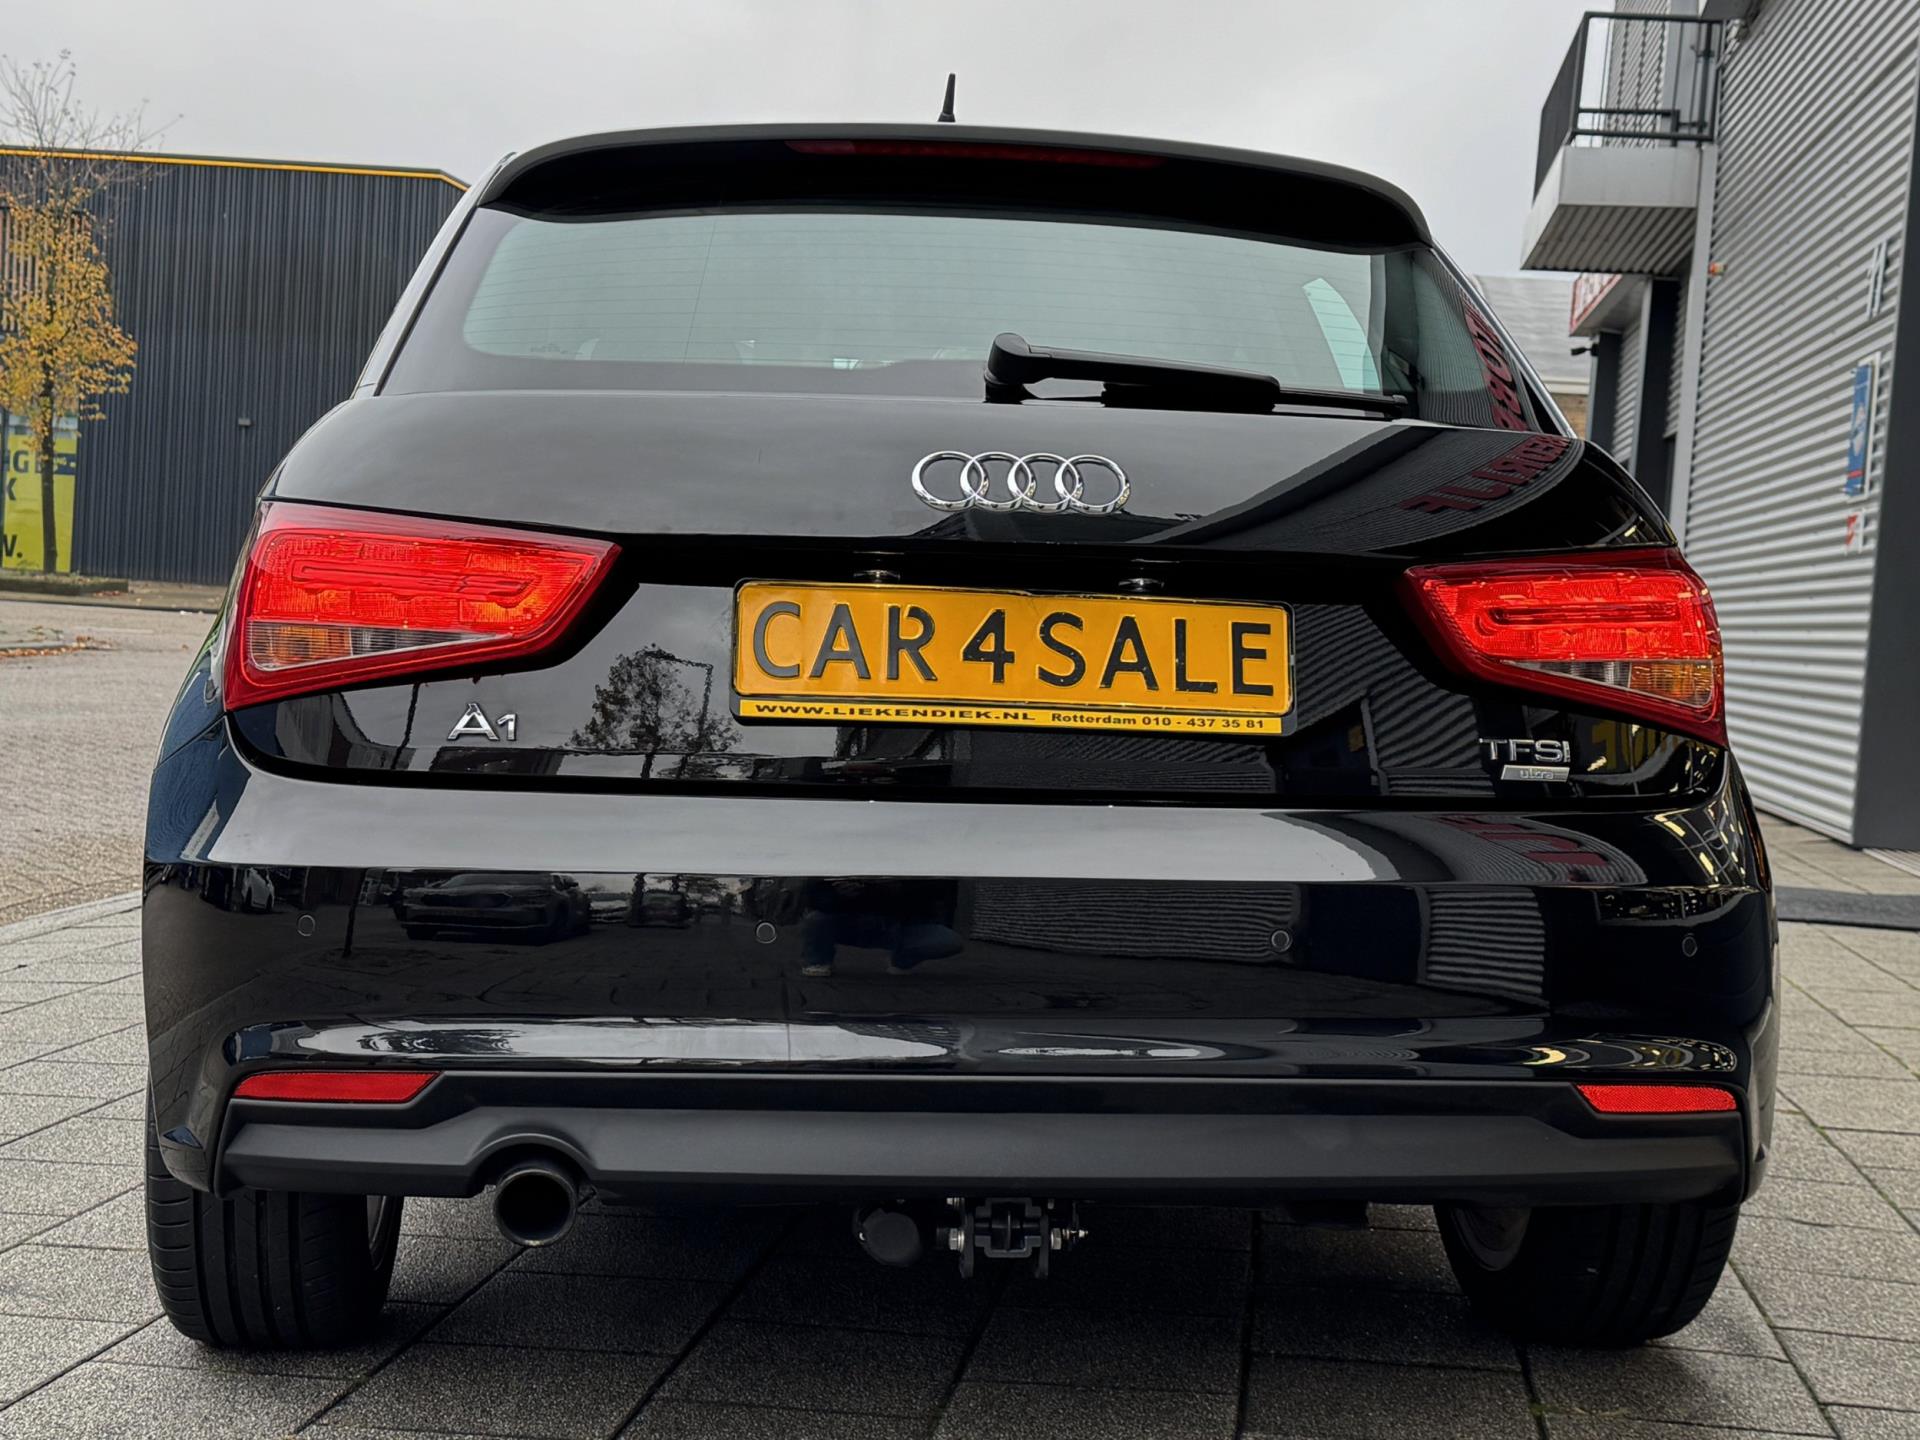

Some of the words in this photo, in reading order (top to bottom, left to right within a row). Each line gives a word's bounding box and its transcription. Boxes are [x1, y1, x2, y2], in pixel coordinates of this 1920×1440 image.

[753, 601, 939, 682] CAR
[962, 608, 1016, 684] 4
[1038, 611, 1275, 697] SALE
[447, 702, 517, 741] A1
[755, 704, 1036, 721] WWW.LIEKENDIEK.NL
[1051, 712, 1137, 726] Rotterdam
[1142, 716, 1172, 727] 010
[1187, 717, 1215, 728] 437
[1222, 718, 1241, 729] 35
[1246, 719, 1264, 729] 81
[1478, 738, 1571, 763] TFSI
